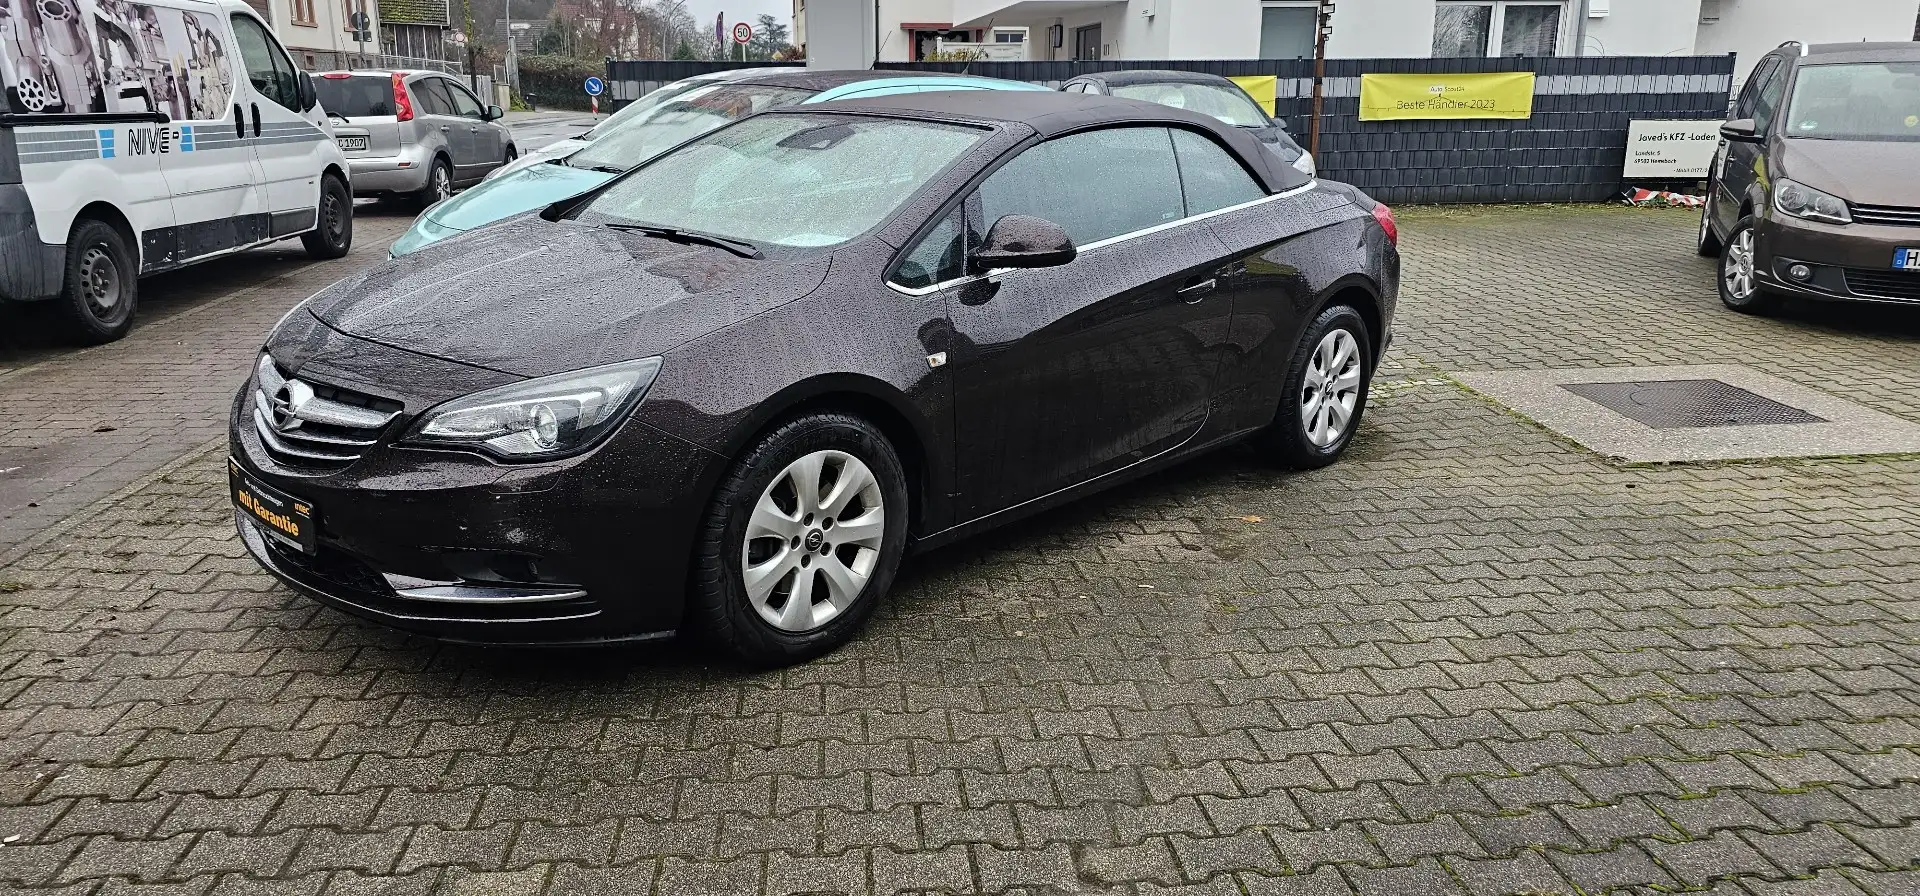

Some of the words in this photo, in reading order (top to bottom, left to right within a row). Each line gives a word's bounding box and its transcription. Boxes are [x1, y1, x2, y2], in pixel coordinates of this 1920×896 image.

[737, 27, 748, 38] 50
[1396, 100, 1425, 110] Beste
[1428, 99, 1468, 110] Händler
[1470, 100, 1495, 108] 2023
[345, 139, 363, 147] 1907
[1905, 251, 1920, 267] H
[239, 489, 253, 510] mit
[253, 498, 299, 536] Garantie
